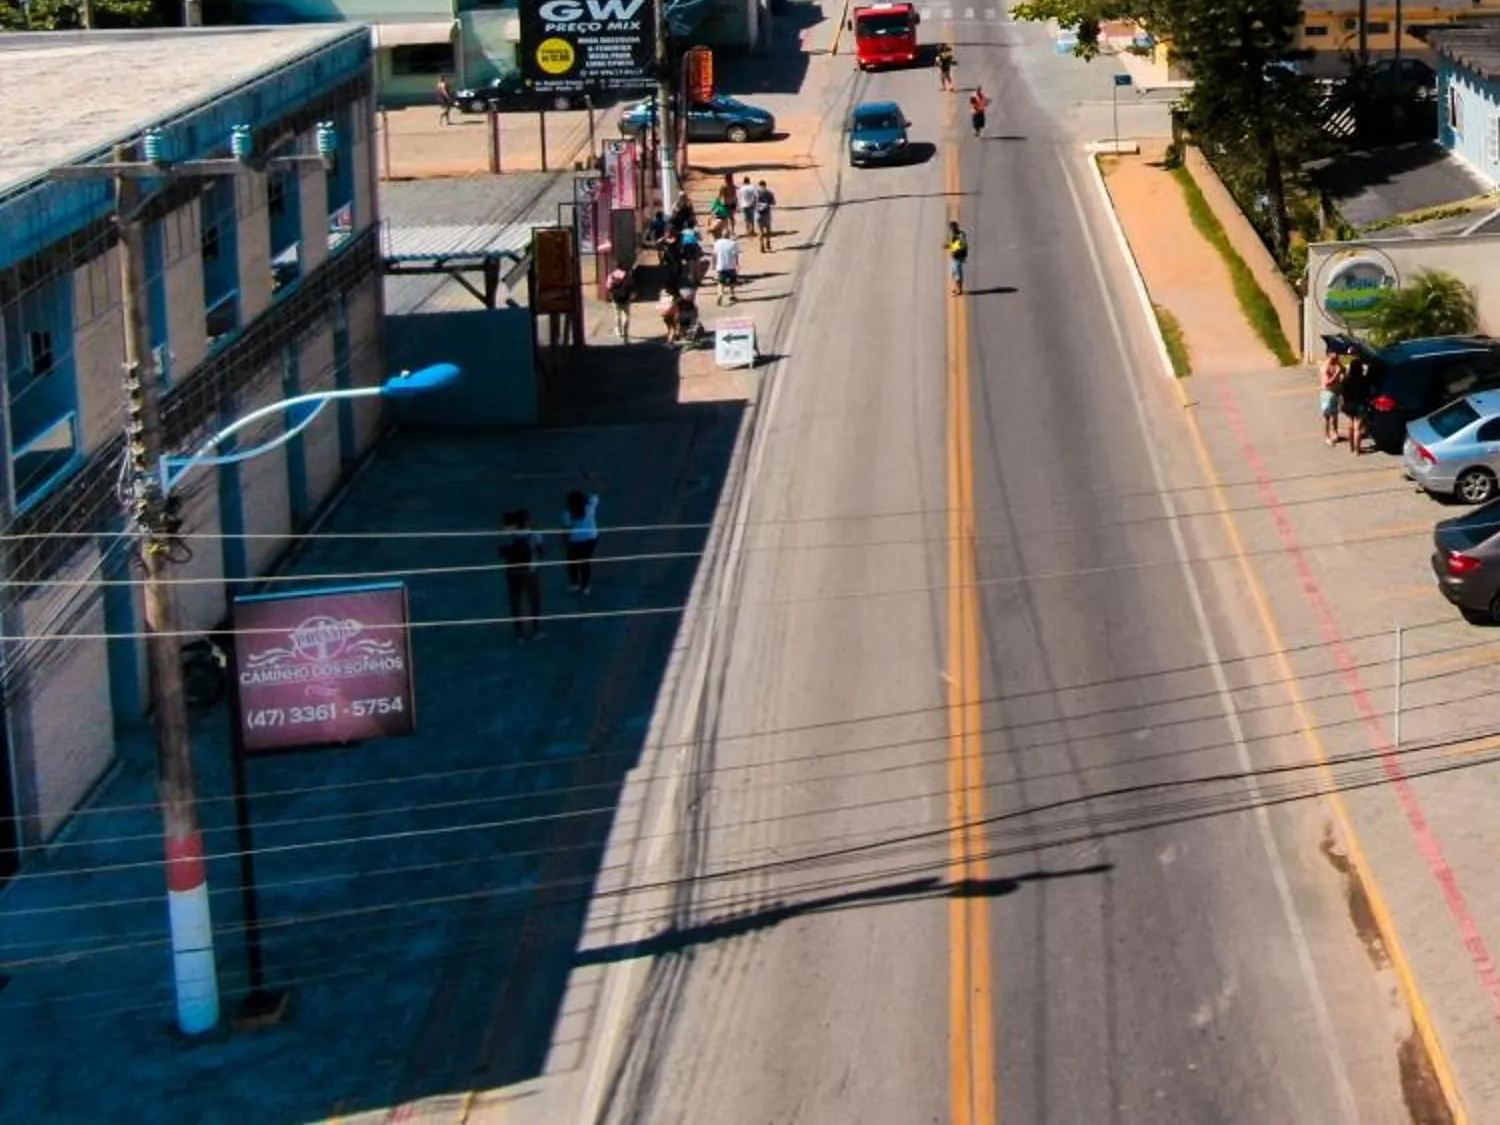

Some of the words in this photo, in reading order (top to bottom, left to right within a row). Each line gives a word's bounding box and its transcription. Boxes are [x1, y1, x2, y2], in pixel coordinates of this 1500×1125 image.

[544, 21, 602, 33] PREÇO
[607, 21, 641, 31] MIX
[239, 665, 309, 685] CAMINHO
[246, 709, 285, 730] (47)
[289, 703, 338, 725] 3361
[351, 695, 404, 717] 5754
